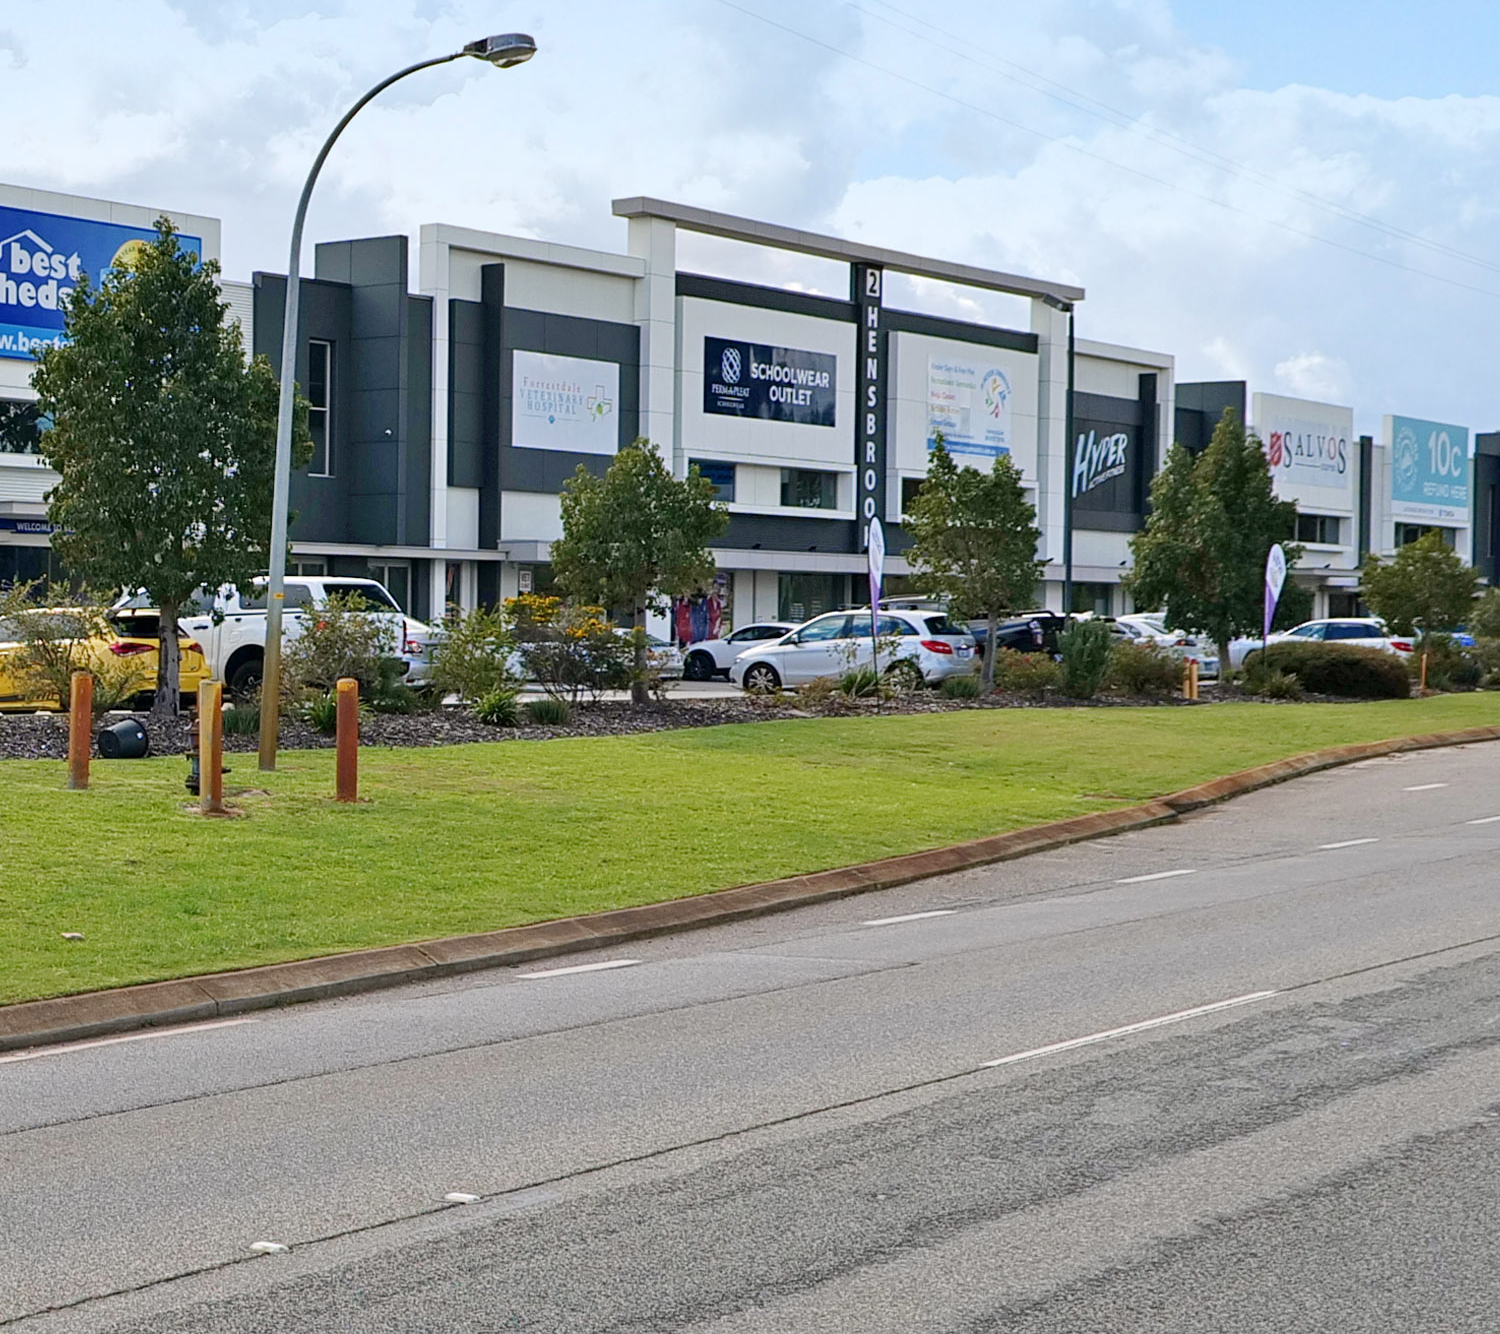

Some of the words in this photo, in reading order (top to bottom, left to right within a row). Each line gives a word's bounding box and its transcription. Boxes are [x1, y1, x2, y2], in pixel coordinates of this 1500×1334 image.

[10, 241, 82, 281] best
[868, 271, 878, 294] 2
[751, 362, 830, 388] SCHOOLWEAR
[527, 400, 577, 415] HOSPITAL
[769, 385, 812, 406] OUTLET
[1072, 429, 1127, 498] HYPER
[1283, 431, 1346, 474] SALVOS
[1428, 430, 1462, 477] 10c
[16, 522, 52, 533] WELCOME
